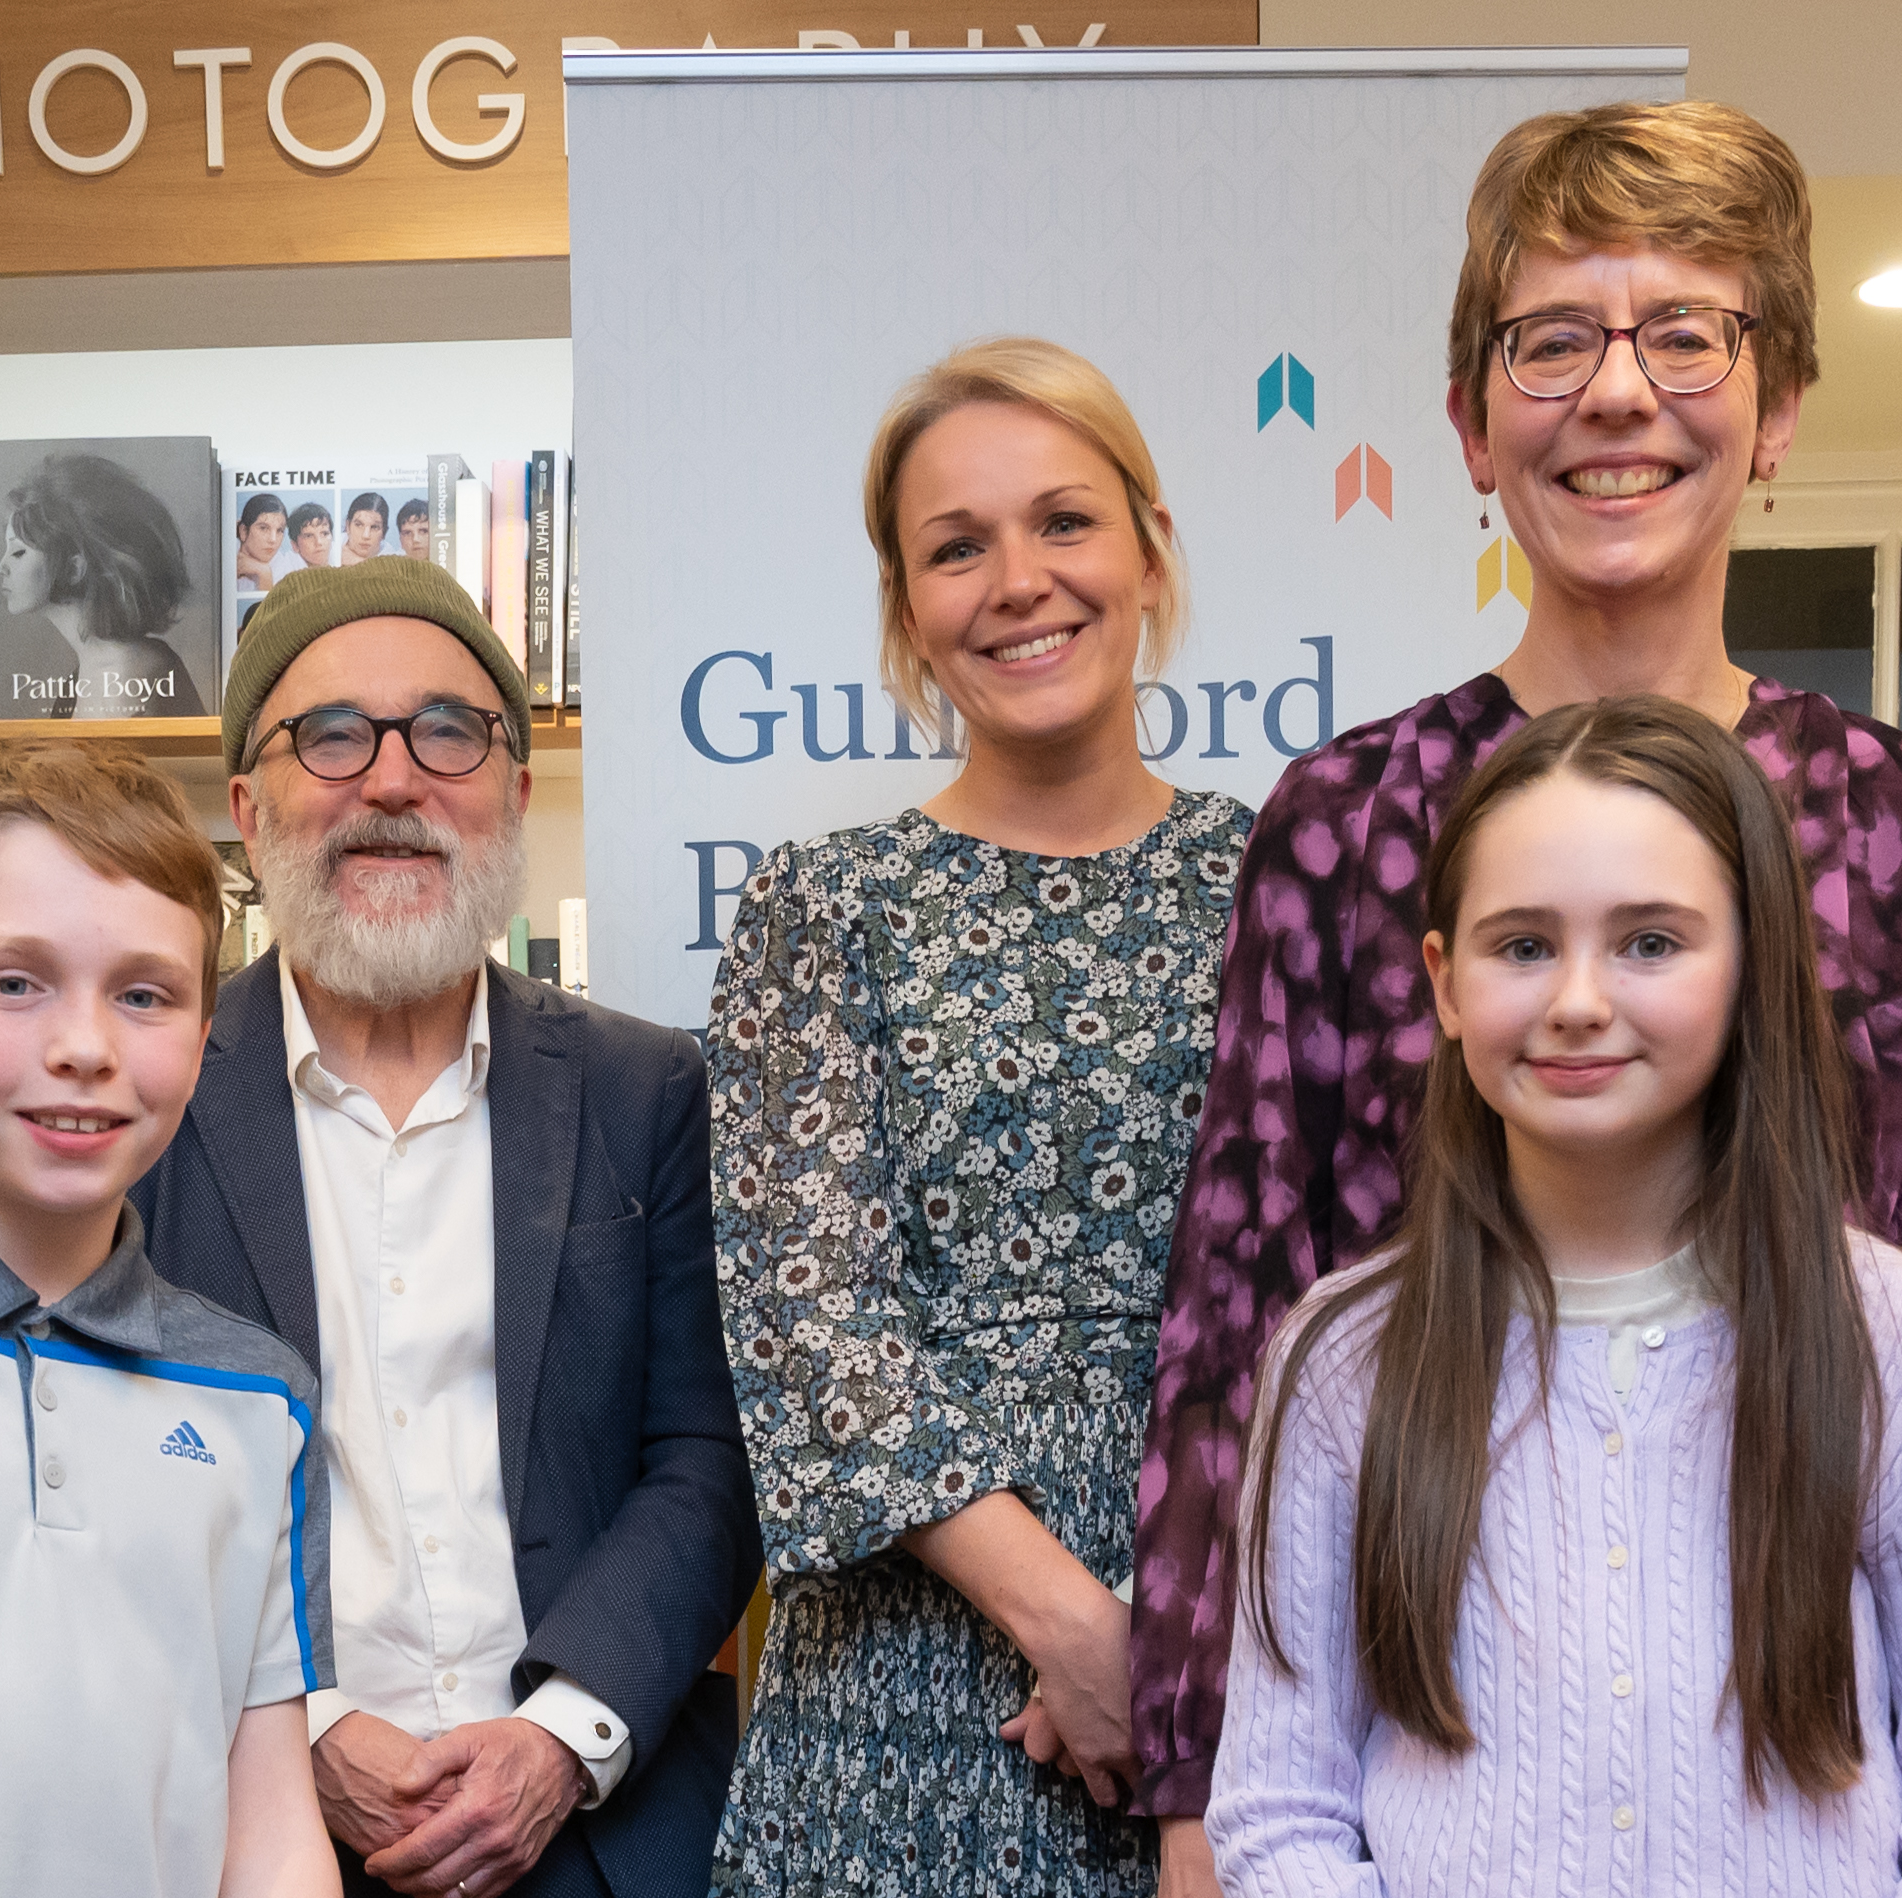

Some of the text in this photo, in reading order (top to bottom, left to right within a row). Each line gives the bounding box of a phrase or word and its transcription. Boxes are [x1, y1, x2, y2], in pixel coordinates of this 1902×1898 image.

[235, 469, 336, 487] FACE TIME
[437, 462, 449, 531] Glasshouse
[534, 510, 549, 616] WHAT WE SEE
[12, 669, 176, 703] Pattie Boyd
[679, 636, 1334, 765] Guilord
[159, 1440, 216, 1466] adidas
